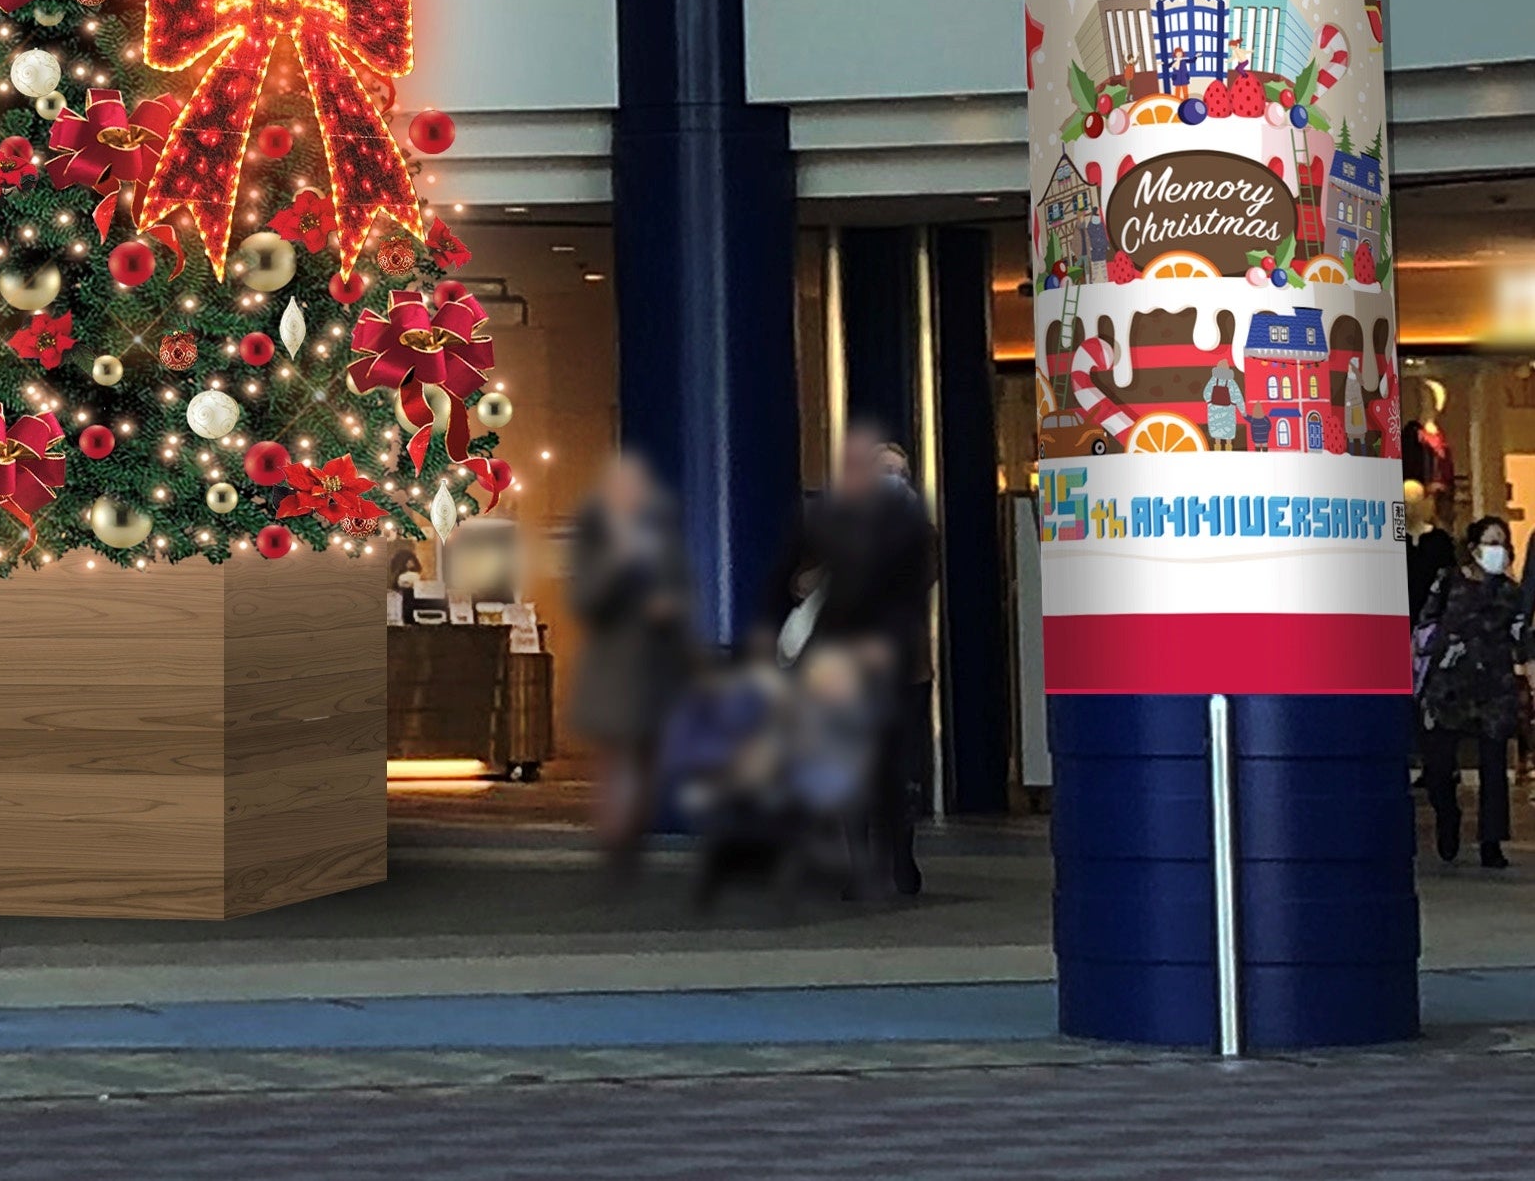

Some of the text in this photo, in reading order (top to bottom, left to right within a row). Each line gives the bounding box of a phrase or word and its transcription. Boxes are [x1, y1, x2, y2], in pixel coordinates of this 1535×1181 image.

[1133, 165, 1274, 217] Memory
[1121, 208, 1281, 254] Christmas
[1131, 496, 1386, 539] ANNIVERSARY
